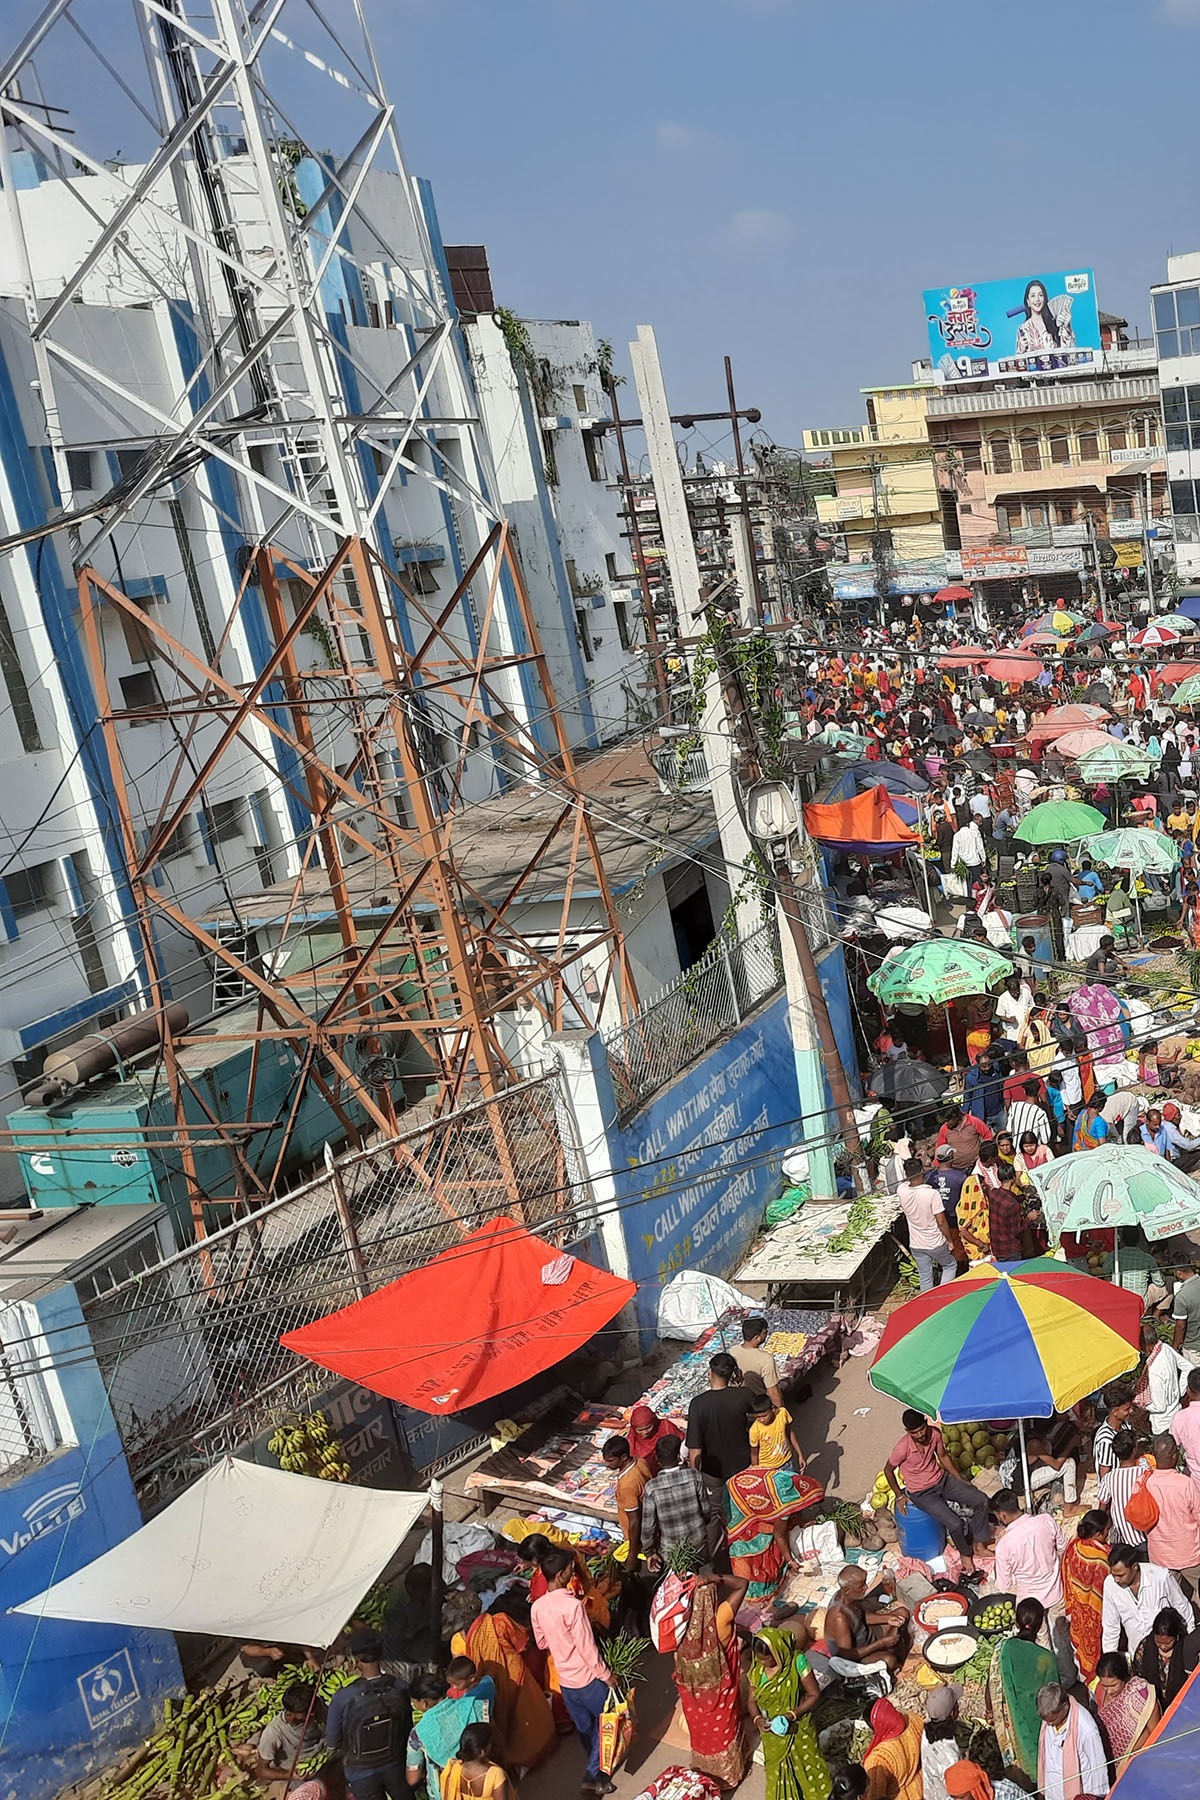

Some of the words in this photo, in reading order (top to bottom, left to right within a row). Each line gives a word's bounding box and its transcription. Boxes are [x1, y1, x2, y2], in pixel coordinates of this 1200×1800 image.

[638, 1128, 667, 1165] CALL
[653, 1203, 680, 1243] CALL
[691, 1202, 720, 1248] डायल
